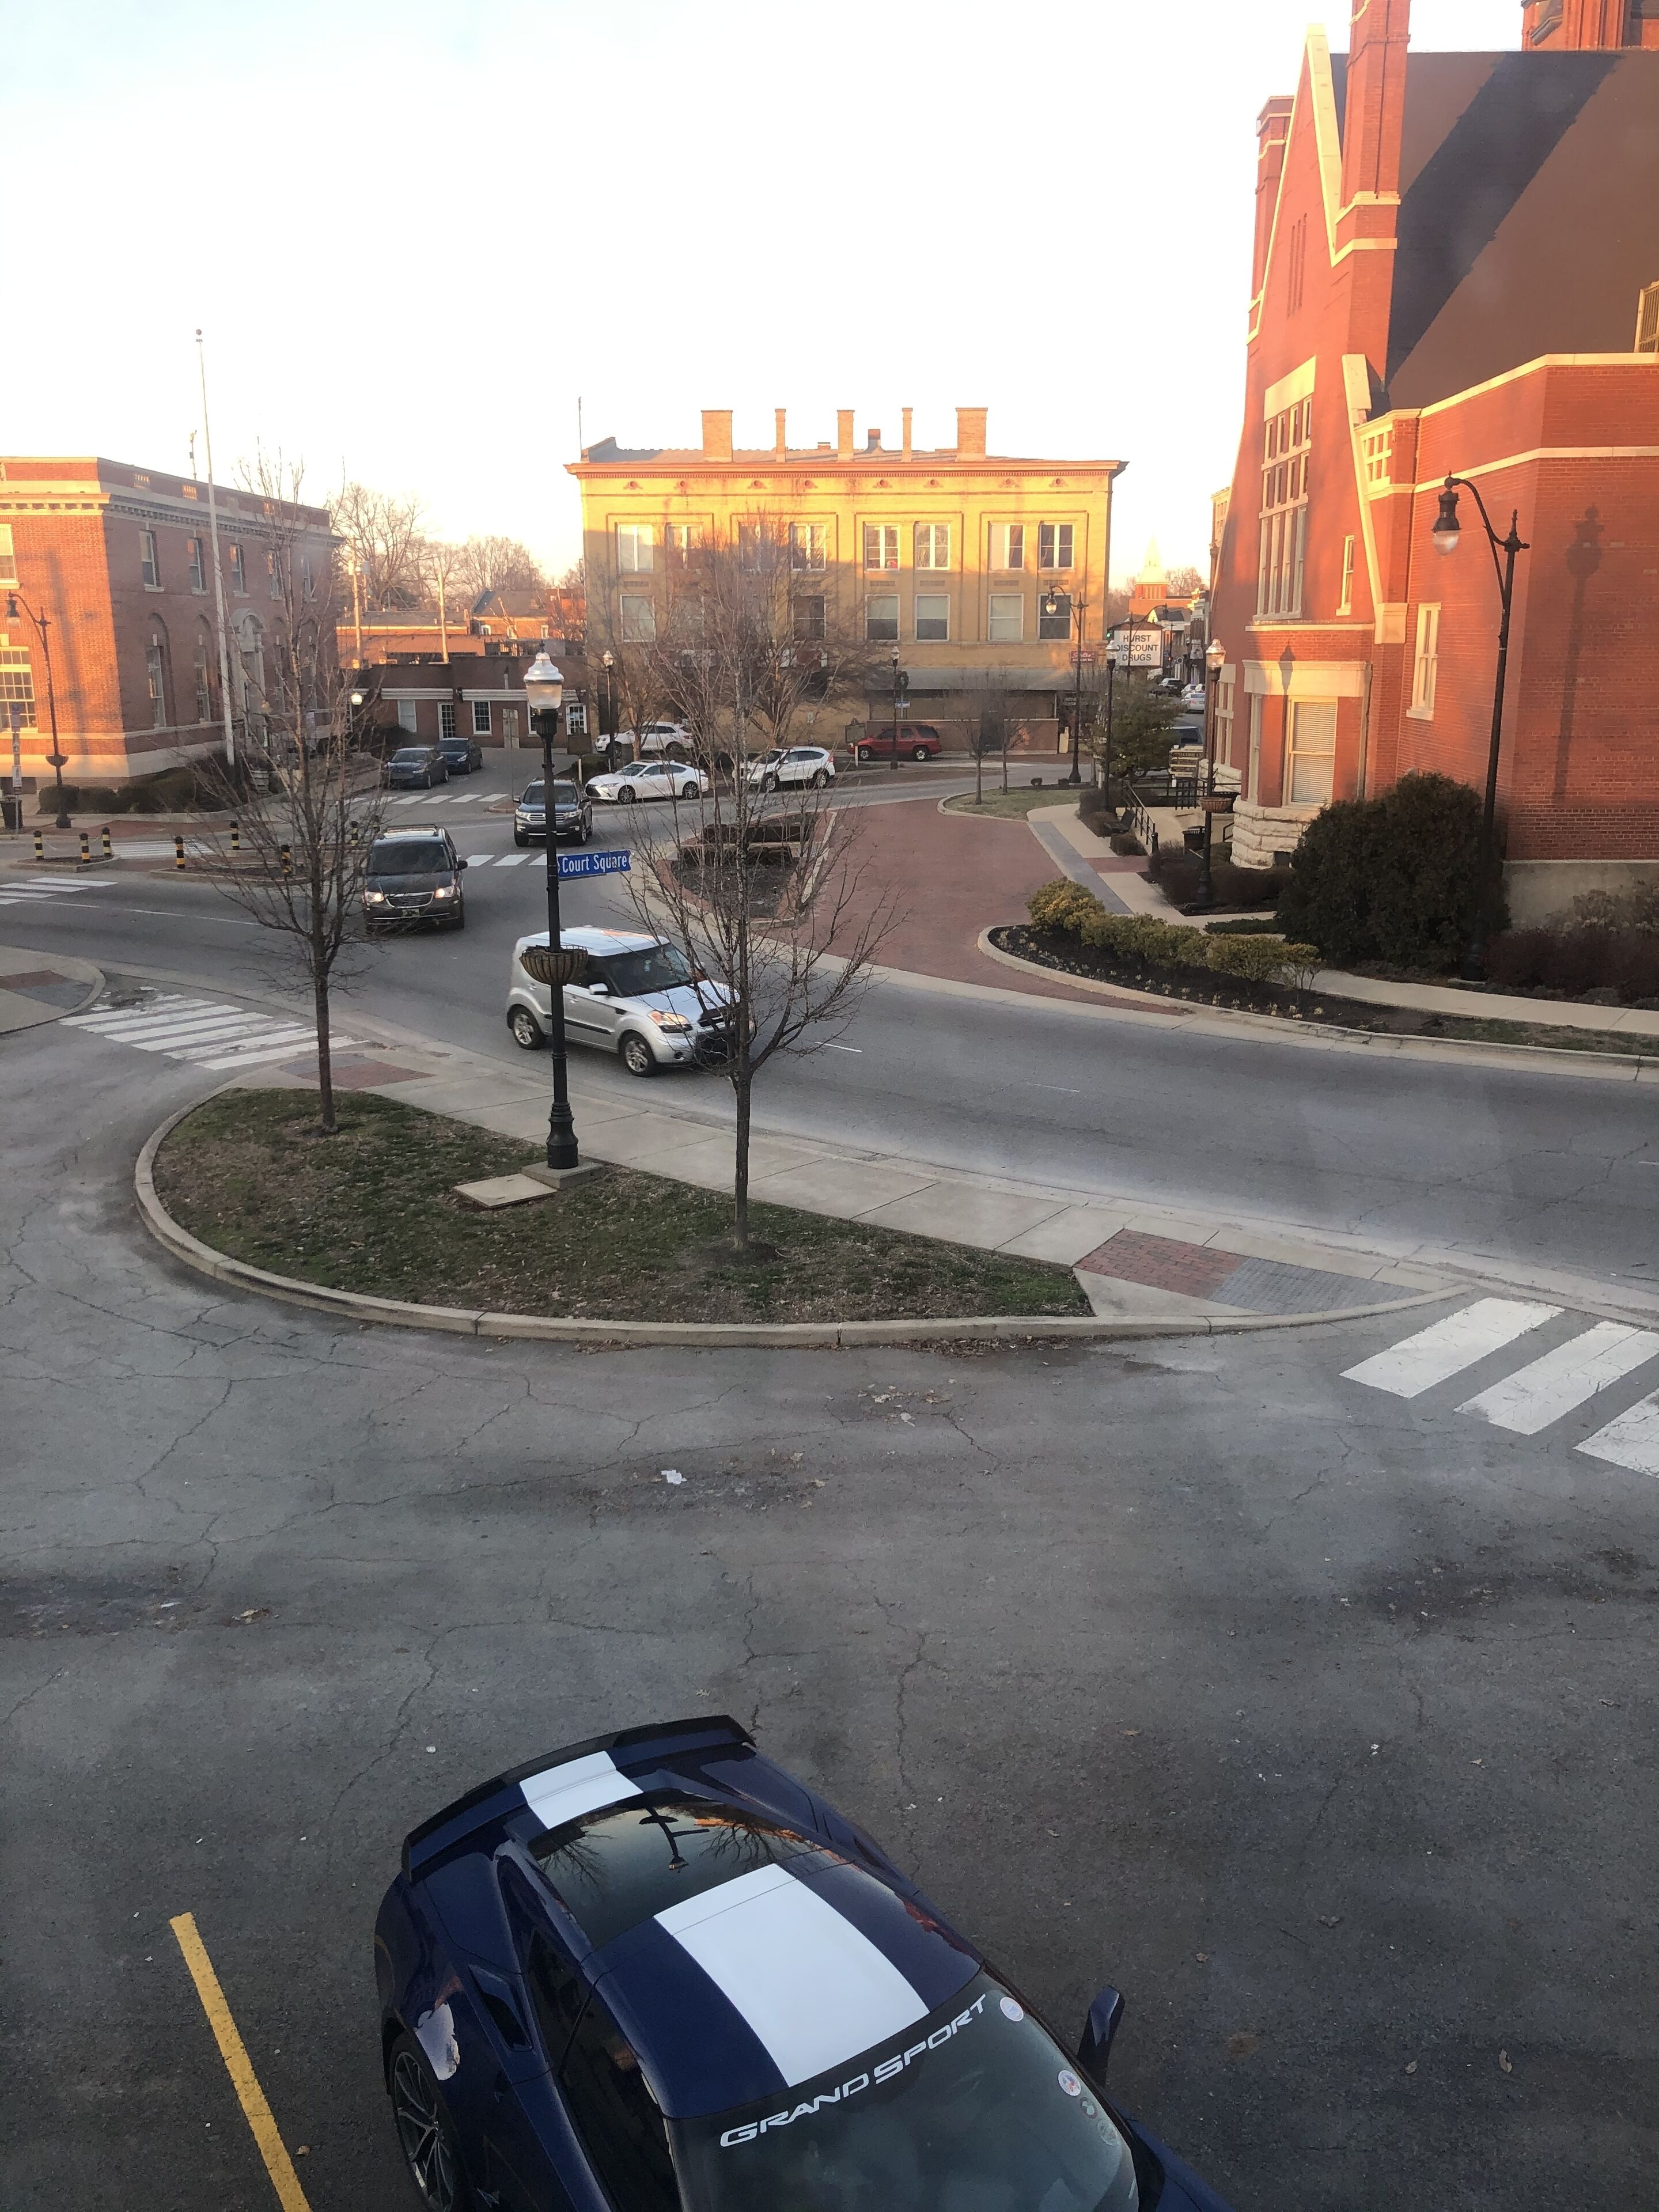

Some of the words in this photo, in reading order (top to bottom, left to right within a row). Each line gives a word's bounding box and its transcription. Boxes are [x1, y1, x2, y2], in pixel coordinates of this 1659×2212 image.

[562, 857, 590, 873] Court
[593, 854, 627, 872] Square
[720, 2073, 869, 2147] GRAND
[874, 1994, 986, 2084] SPORT
